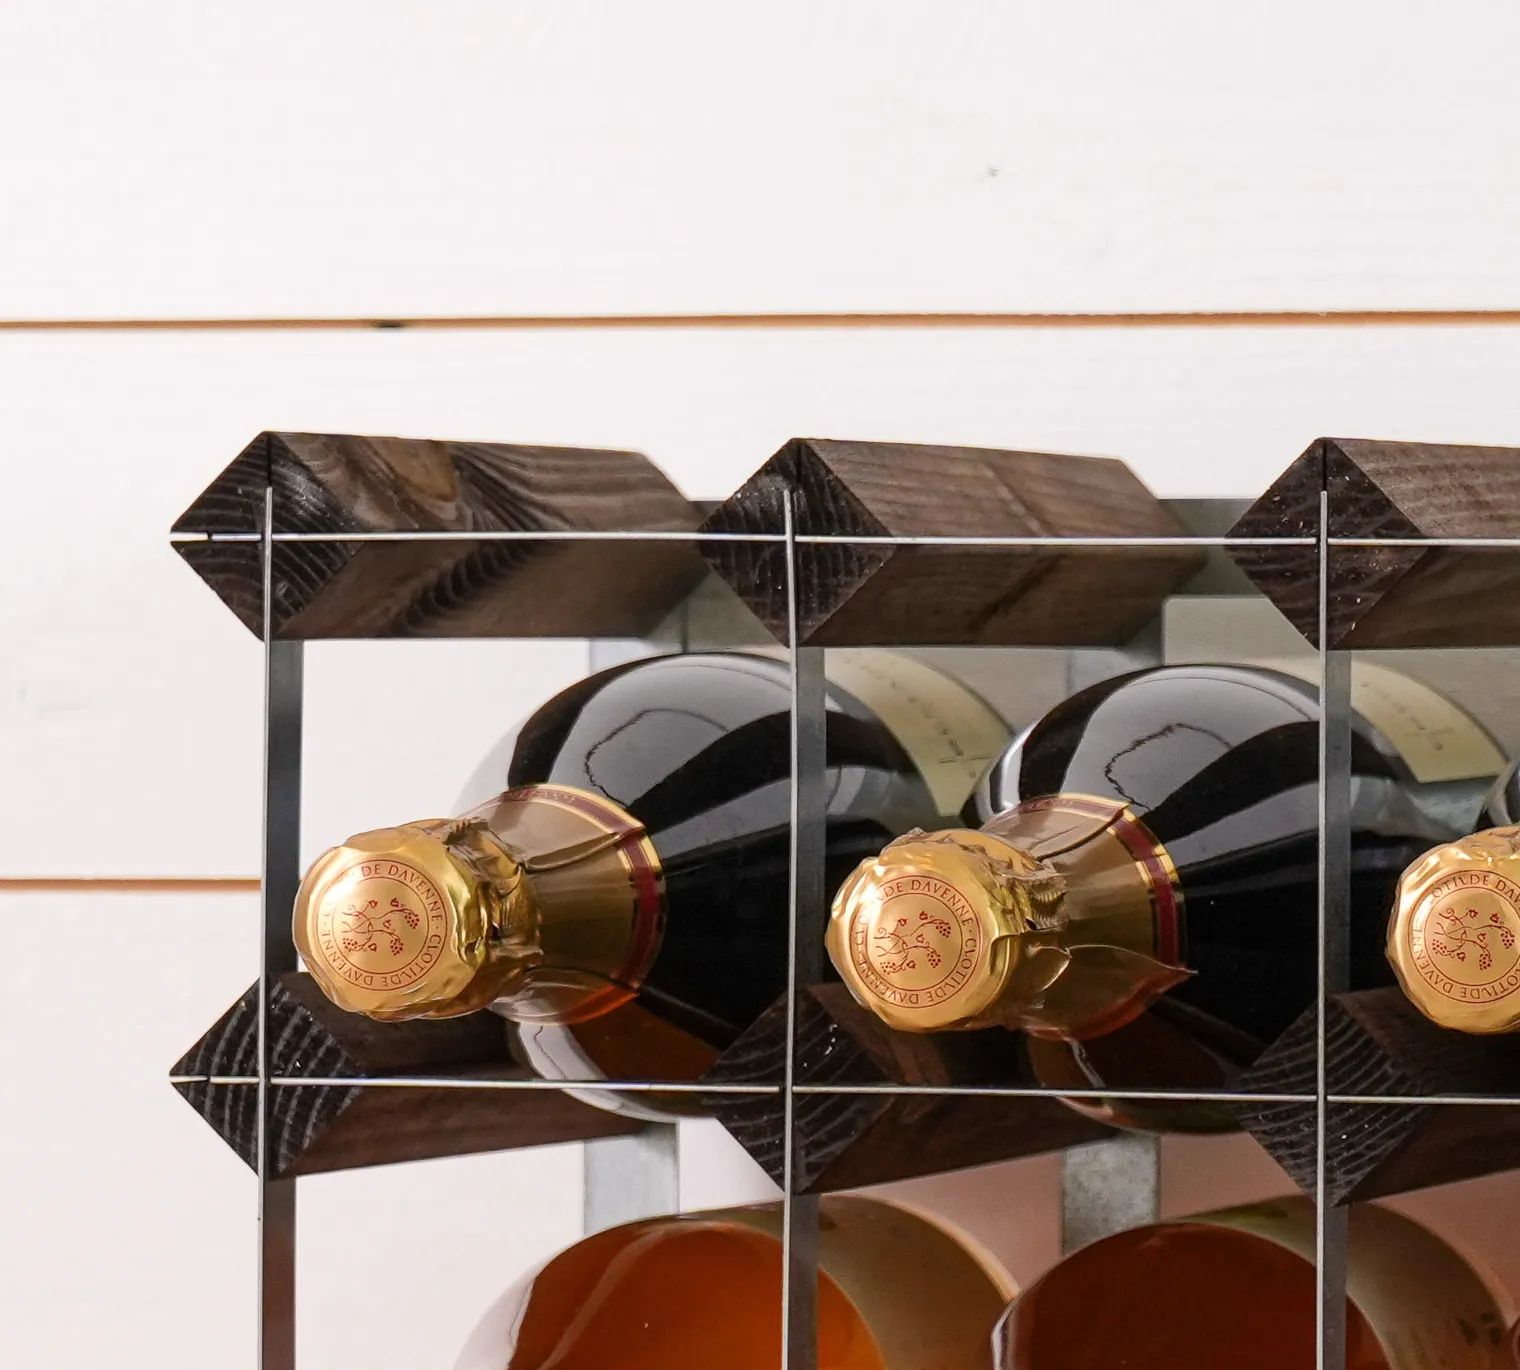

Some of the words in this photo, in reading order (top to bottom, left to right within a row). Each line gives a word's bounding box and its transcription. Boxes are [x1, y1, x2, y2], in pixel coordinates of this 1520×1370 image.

[387, 863, 443, 922] DAVENNE
[910, 878, 977, 928] DAVENNE
[377, 932, 443, 987] CLOTILDE
[923, 937, 977, 1003] CLOTILDE
